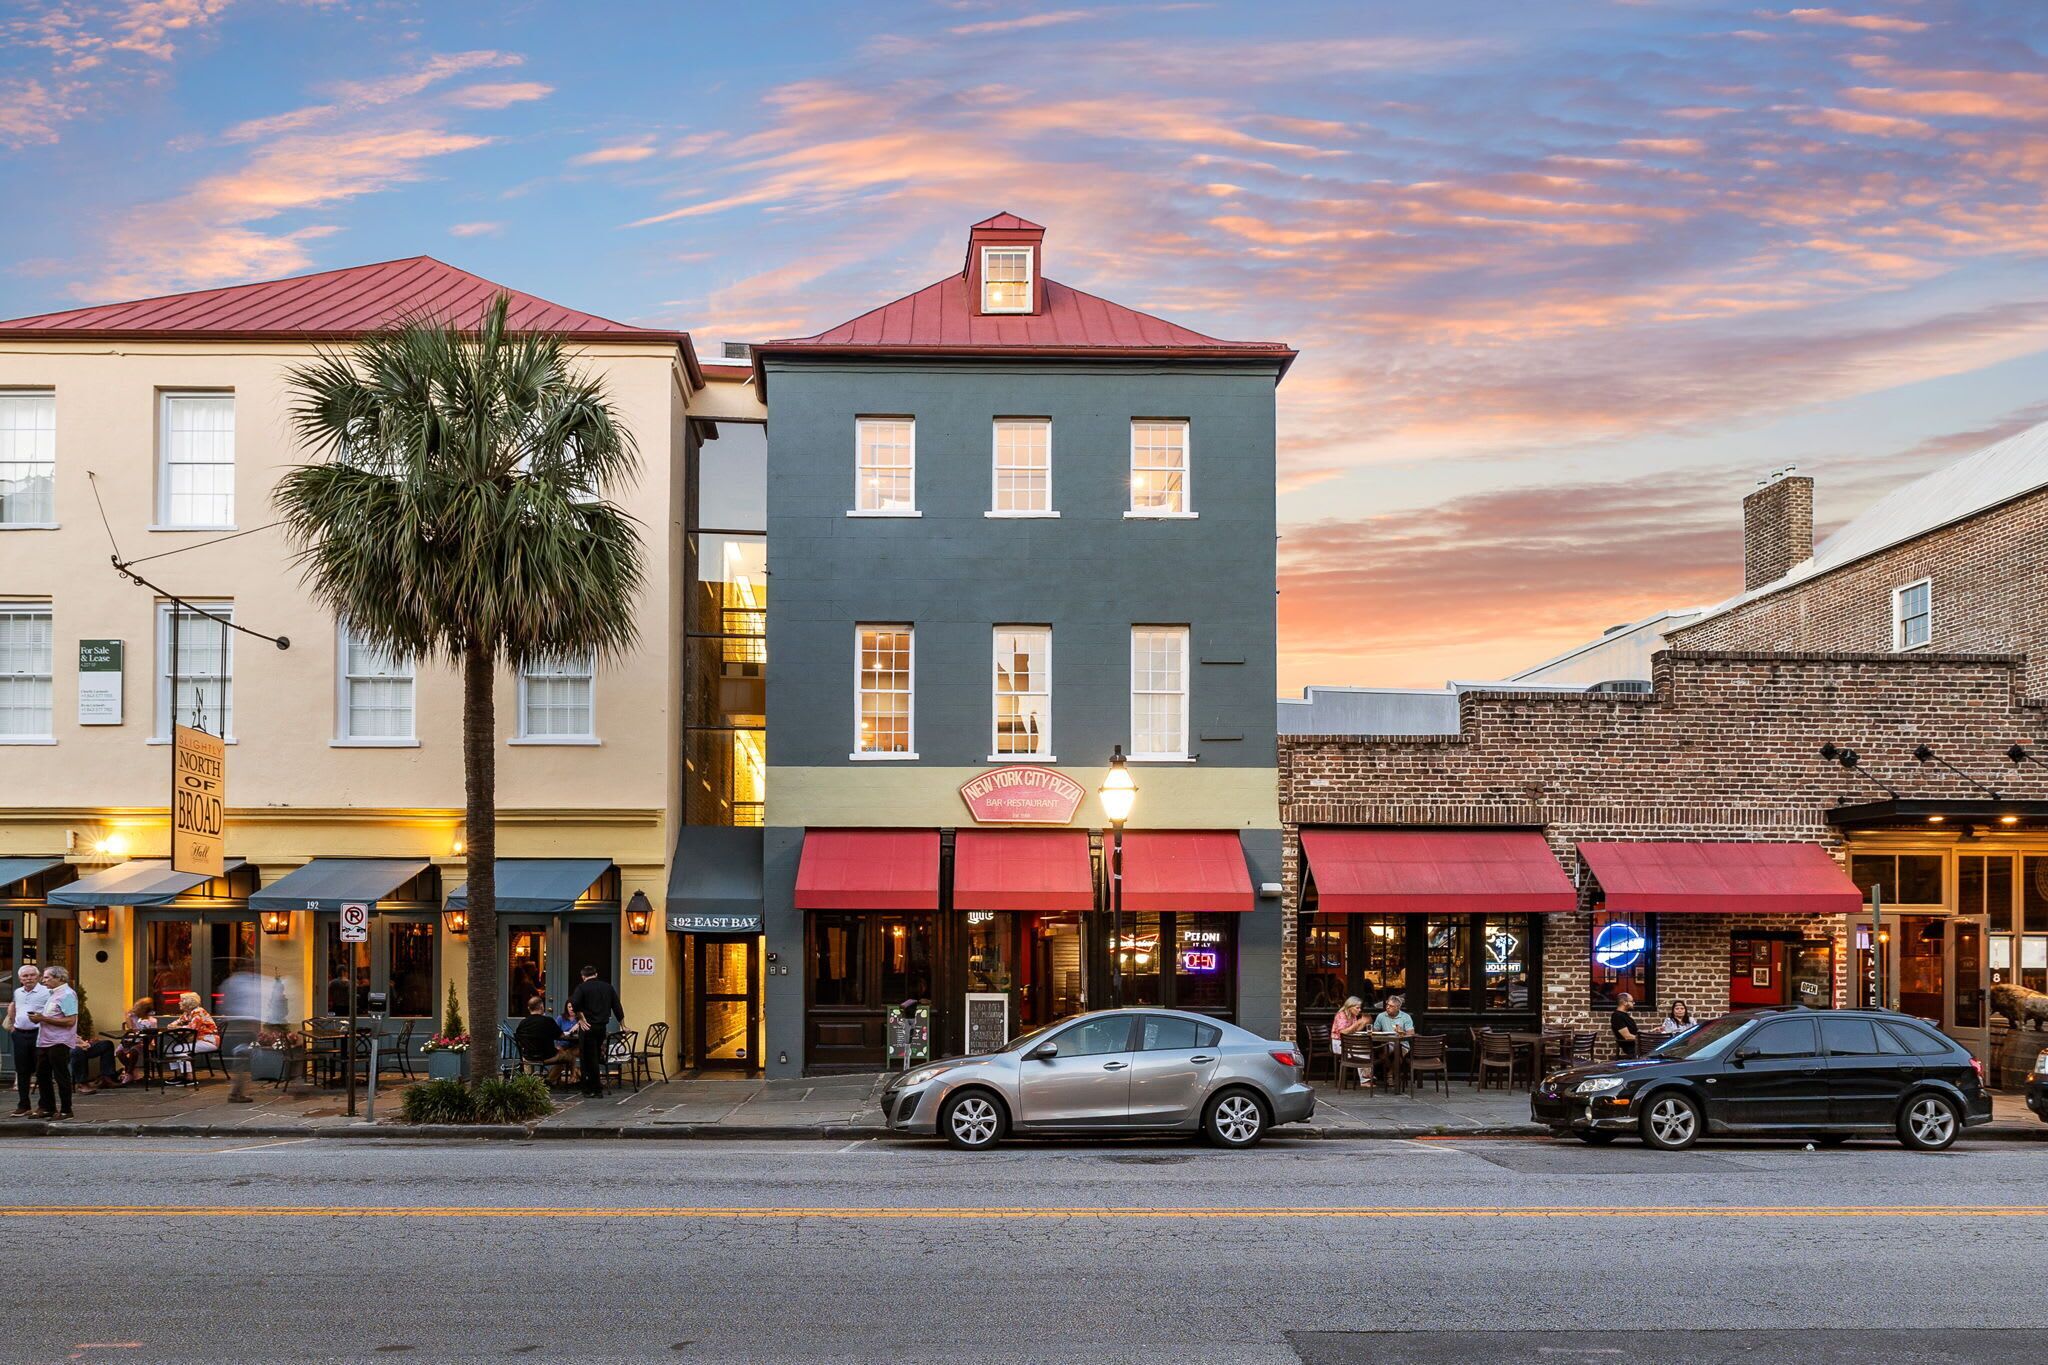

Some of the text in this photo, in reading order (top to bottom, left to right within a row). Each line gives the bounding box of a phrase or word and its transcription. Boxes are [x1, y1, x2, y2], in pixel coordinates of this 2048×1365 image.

[81, 646, 110, 654] For Sale
[80, 654, 111, 662] & Lease
[179, 735, 222, 754] SLIGHTLY
[179, 750, 221, 778] NORTH
[184, 776, 216, 790] OF
[965, 770, 1082, 803] NEW YORK CITY PIZZA
[986, 799, 1059, 808] BAR RESTAURANT
[178, 789, 222, 835] BROAD
[306, 900, 319, 910] 192
[673, 917, 758, 928] 192 EAST BAY
[631, 958, 653, 971] FDC
[1801, 982, 1817, 994] OPEN
